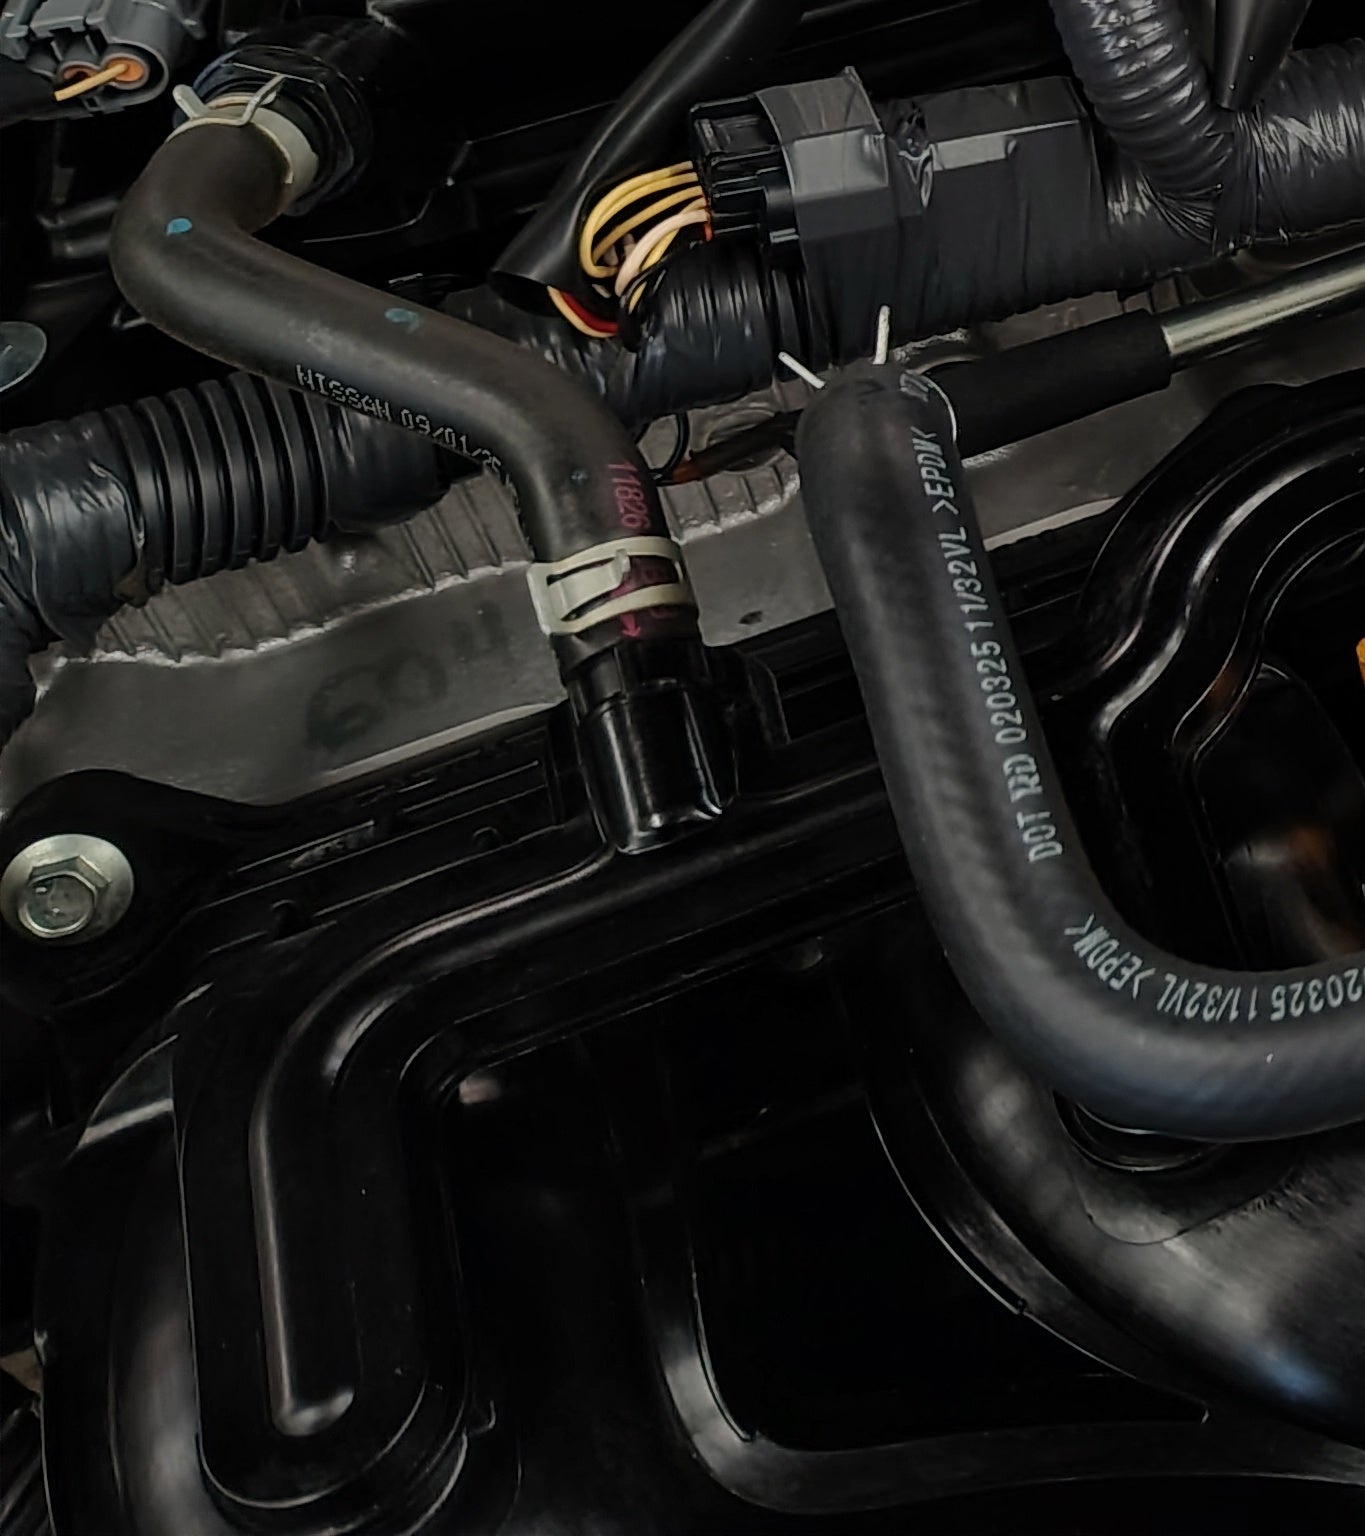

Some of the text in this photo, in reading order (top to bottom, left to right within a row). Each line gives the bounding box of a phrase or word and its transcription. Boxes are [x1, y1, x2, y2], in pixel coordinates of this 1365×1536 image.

[296, 364, 393, 423] NISSAN
[969, 640, 1028, 745] 020325
[1015, 809, 1064, 864] DOT
